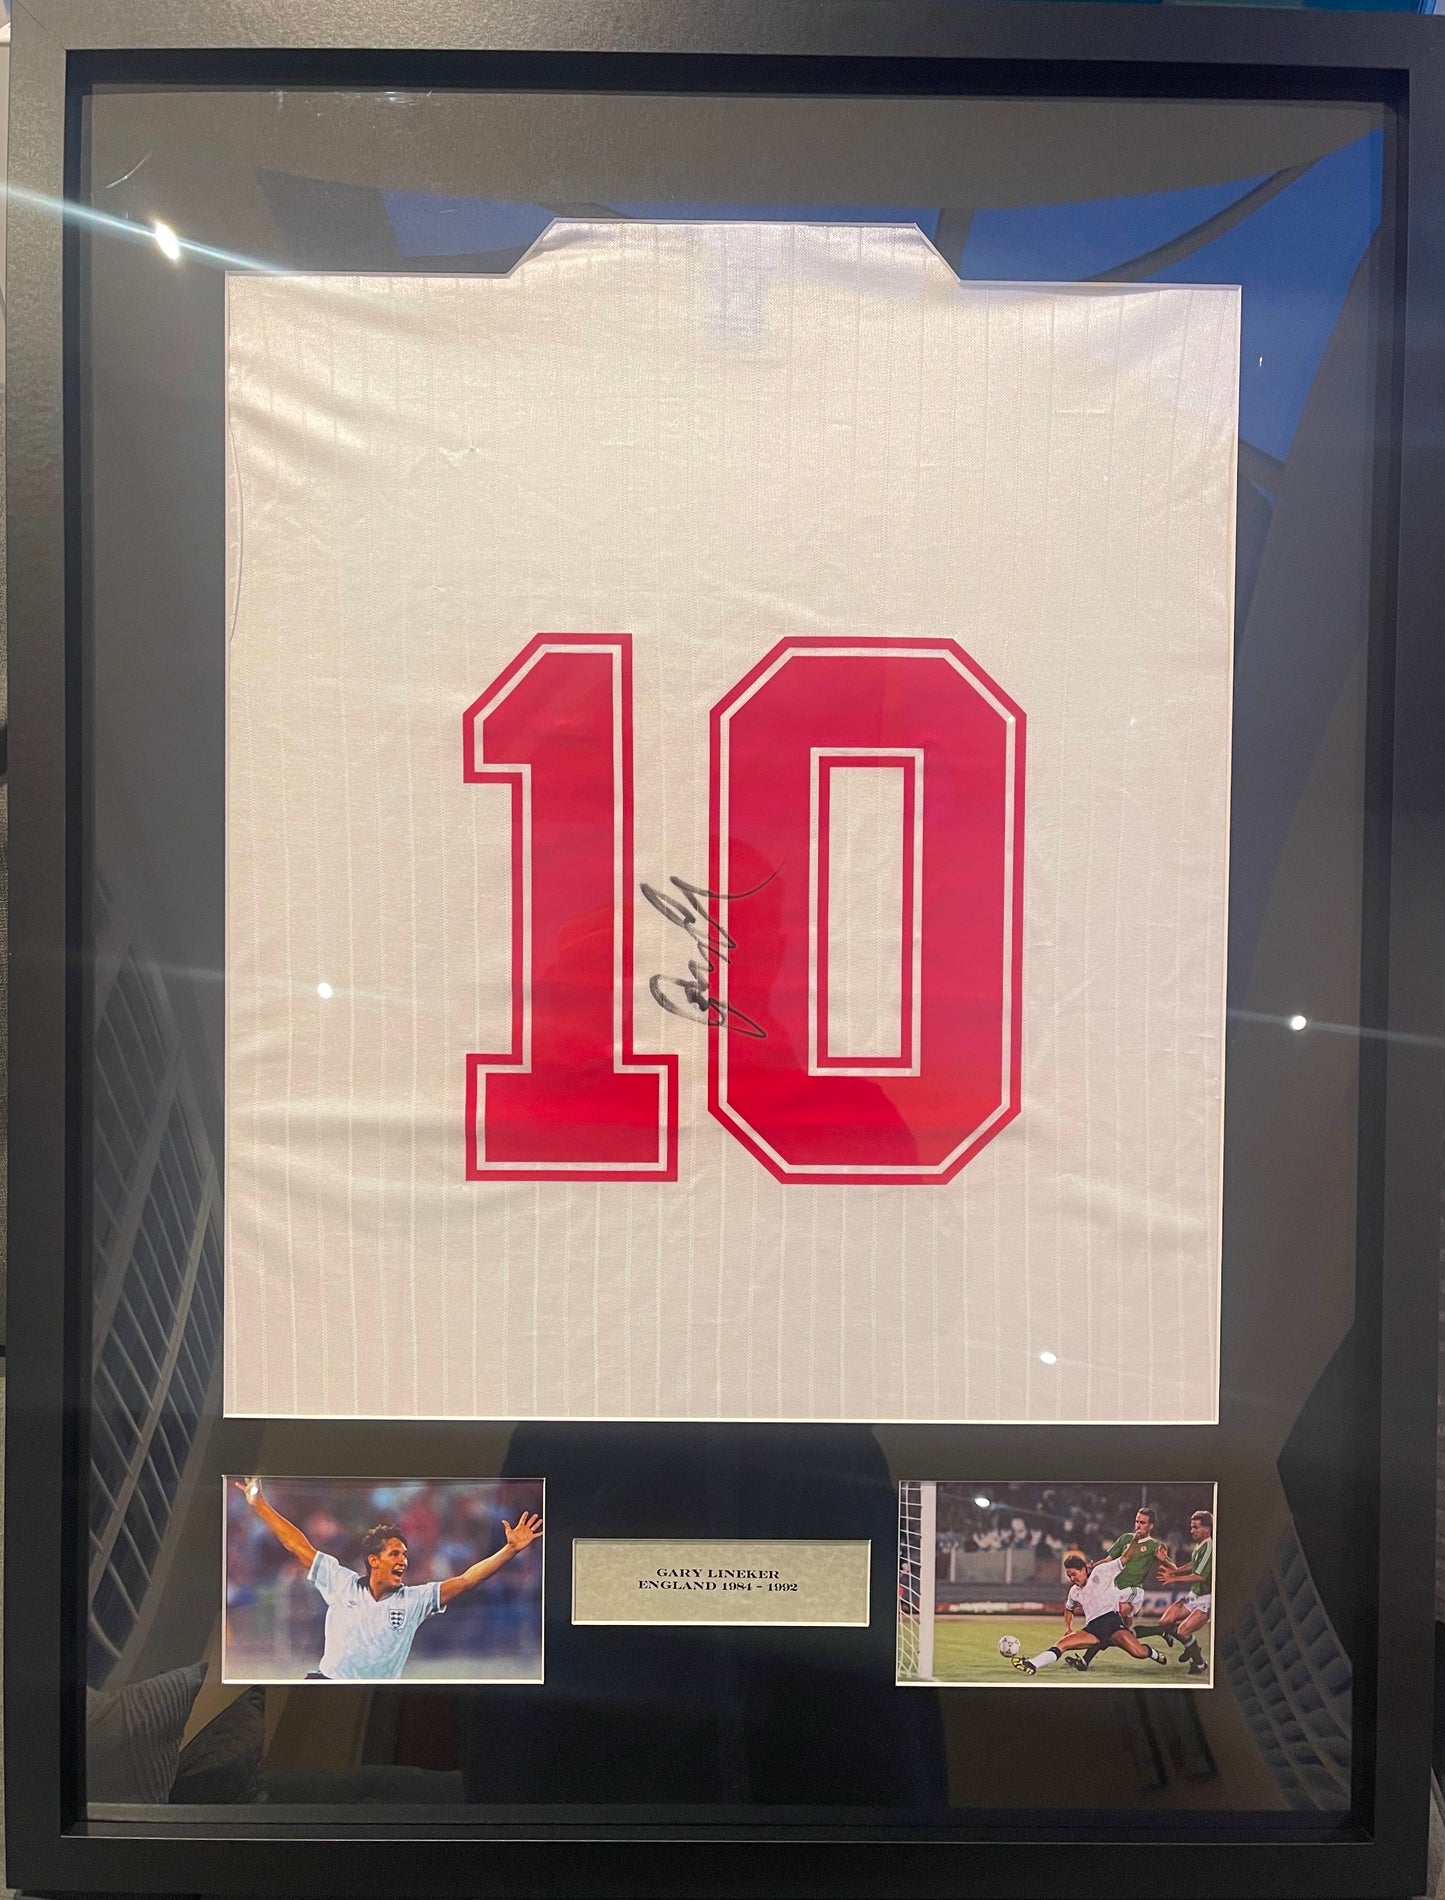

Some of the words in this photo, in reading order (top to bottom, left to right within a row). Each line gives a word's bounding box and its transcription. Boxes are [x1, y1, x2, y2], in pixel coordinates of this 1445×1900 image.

[463, 633, 1026, 1185] 10
[656, 1568, 702, 1578] GARY
[708, 1569, 780, 1579] LINEKER
[638, 1580, 717, 1590] ENGLAND
[721, 1582, 752, 1591] 1984
[767, 1583, 798, 1592] 1992
